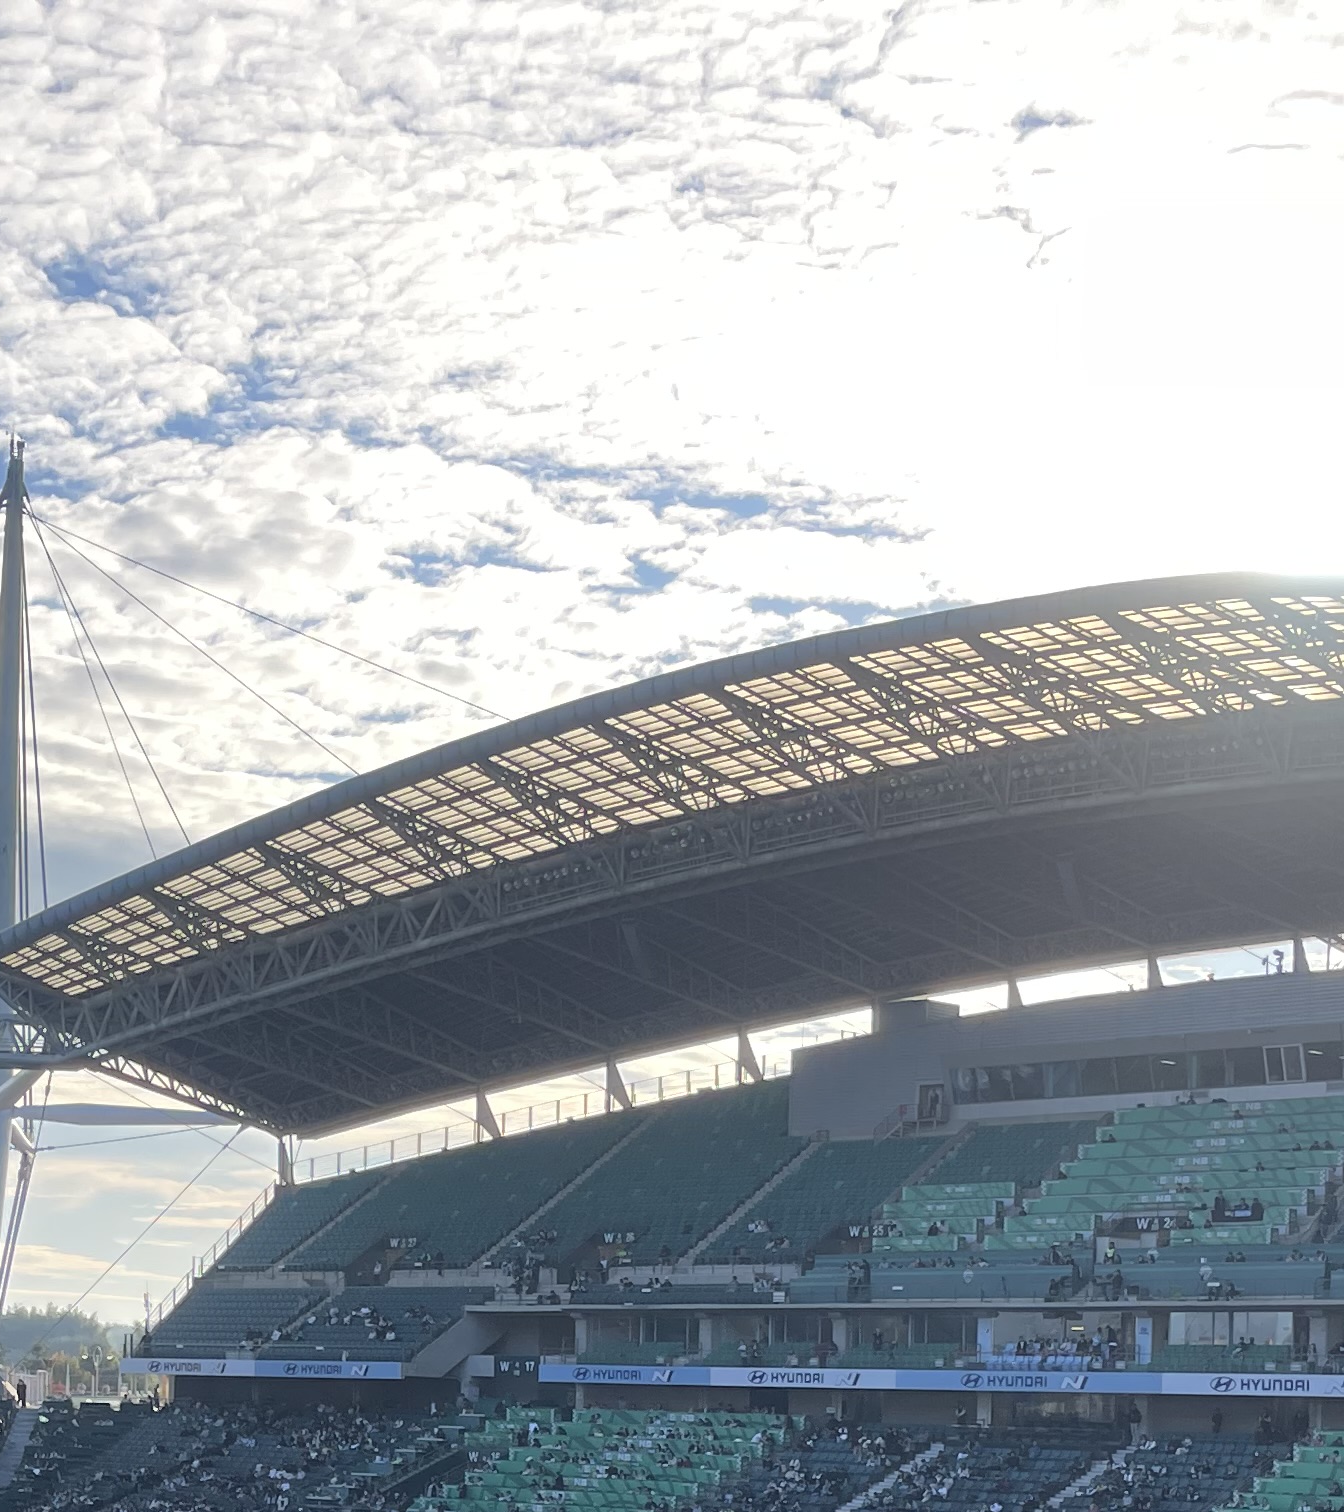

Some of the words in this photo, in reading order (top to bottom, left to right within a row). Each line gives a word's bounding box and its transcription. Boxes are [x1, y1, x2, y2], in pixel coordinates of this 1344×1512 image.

[163, 1362, 202, 1373] HYUNDAI
[301, 1363, 342, 1375] HYUNDAI
[499, 1361, 510, 1372] W
[524, 1361, 535, 1372] 17
[593, 1370, 641, 1382] HYUNDAI
[770, 1372, 825, 1385] HYUNDAI
[987, 1375, 1048, 1388] HYUNDAI
[1240, 1378, 1310, 1393] HYUNDAI
